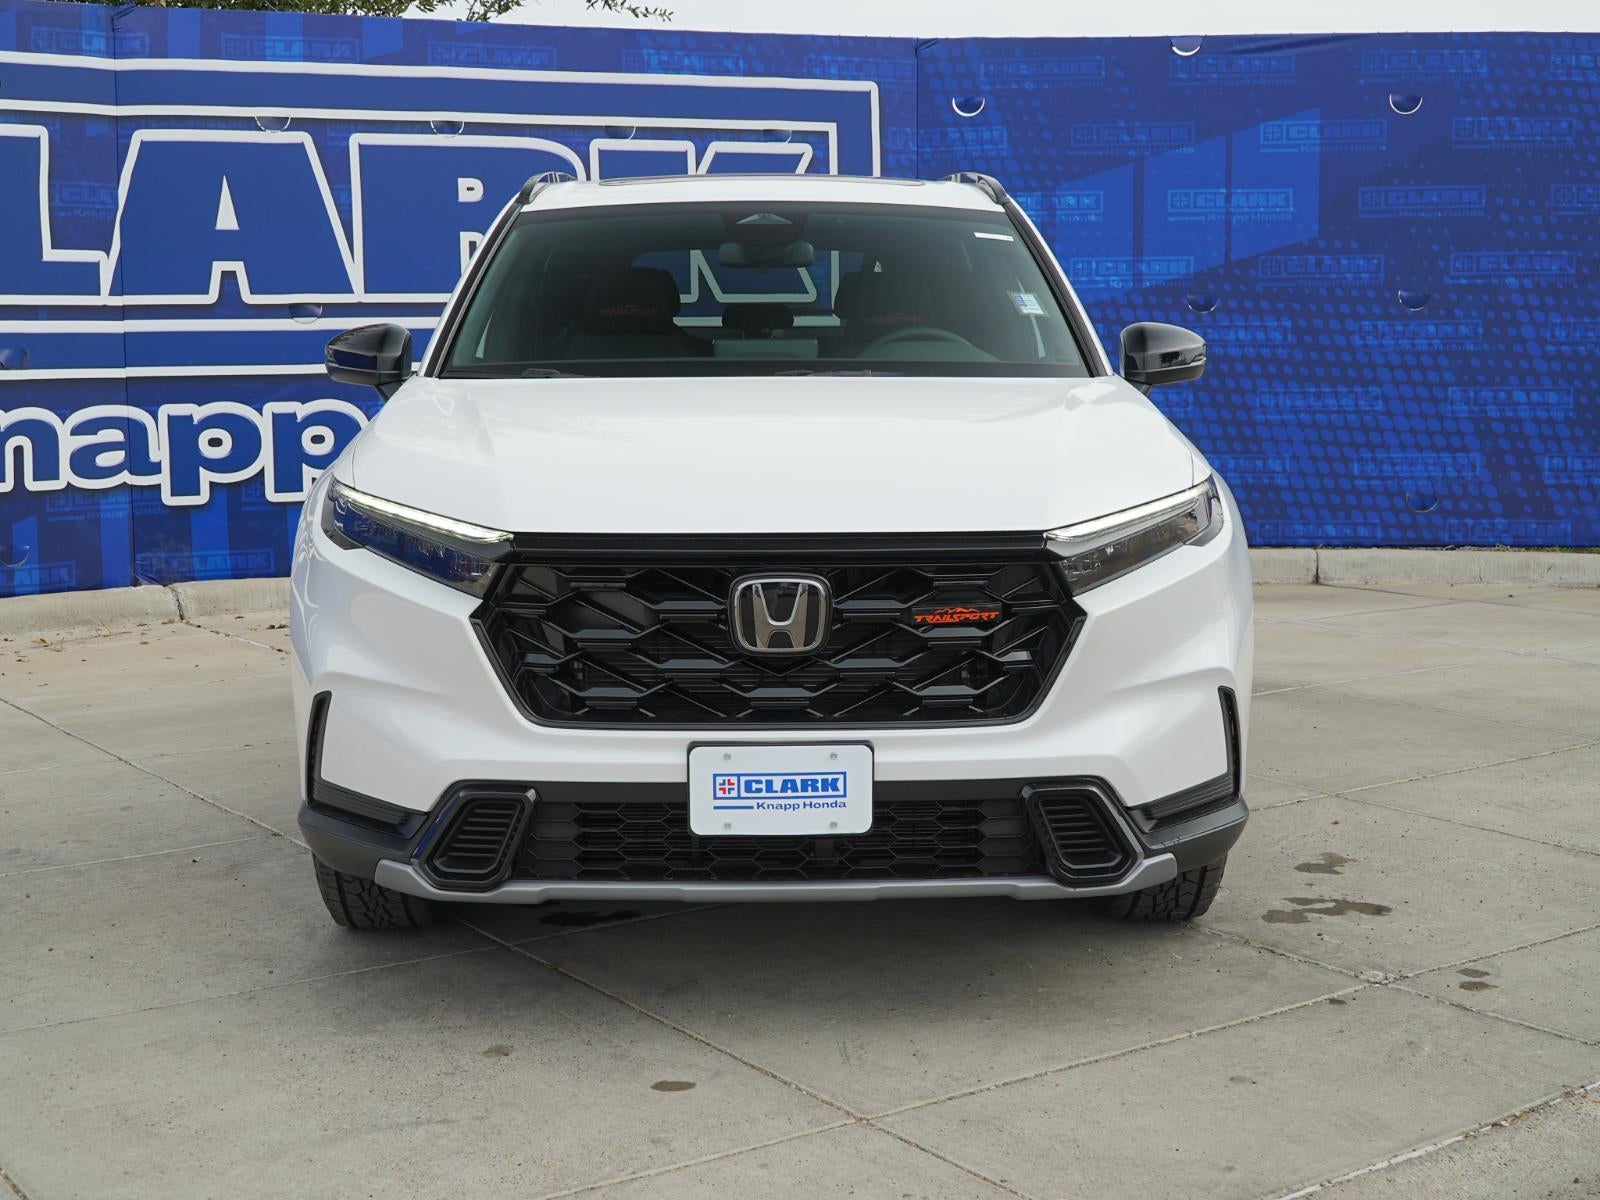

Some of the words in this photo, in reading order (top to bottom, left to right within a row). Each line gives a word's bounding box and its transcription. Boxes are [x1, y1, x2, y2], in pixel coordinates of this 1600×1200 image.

[0, 398, 369, 506] napp
[914, 611, 999, 624] TRAILSPORT
[744, 777, 841, 794] CLARK
[756, 802, 800, 812] Knapp
[803, 800, 847, 810] Honda
